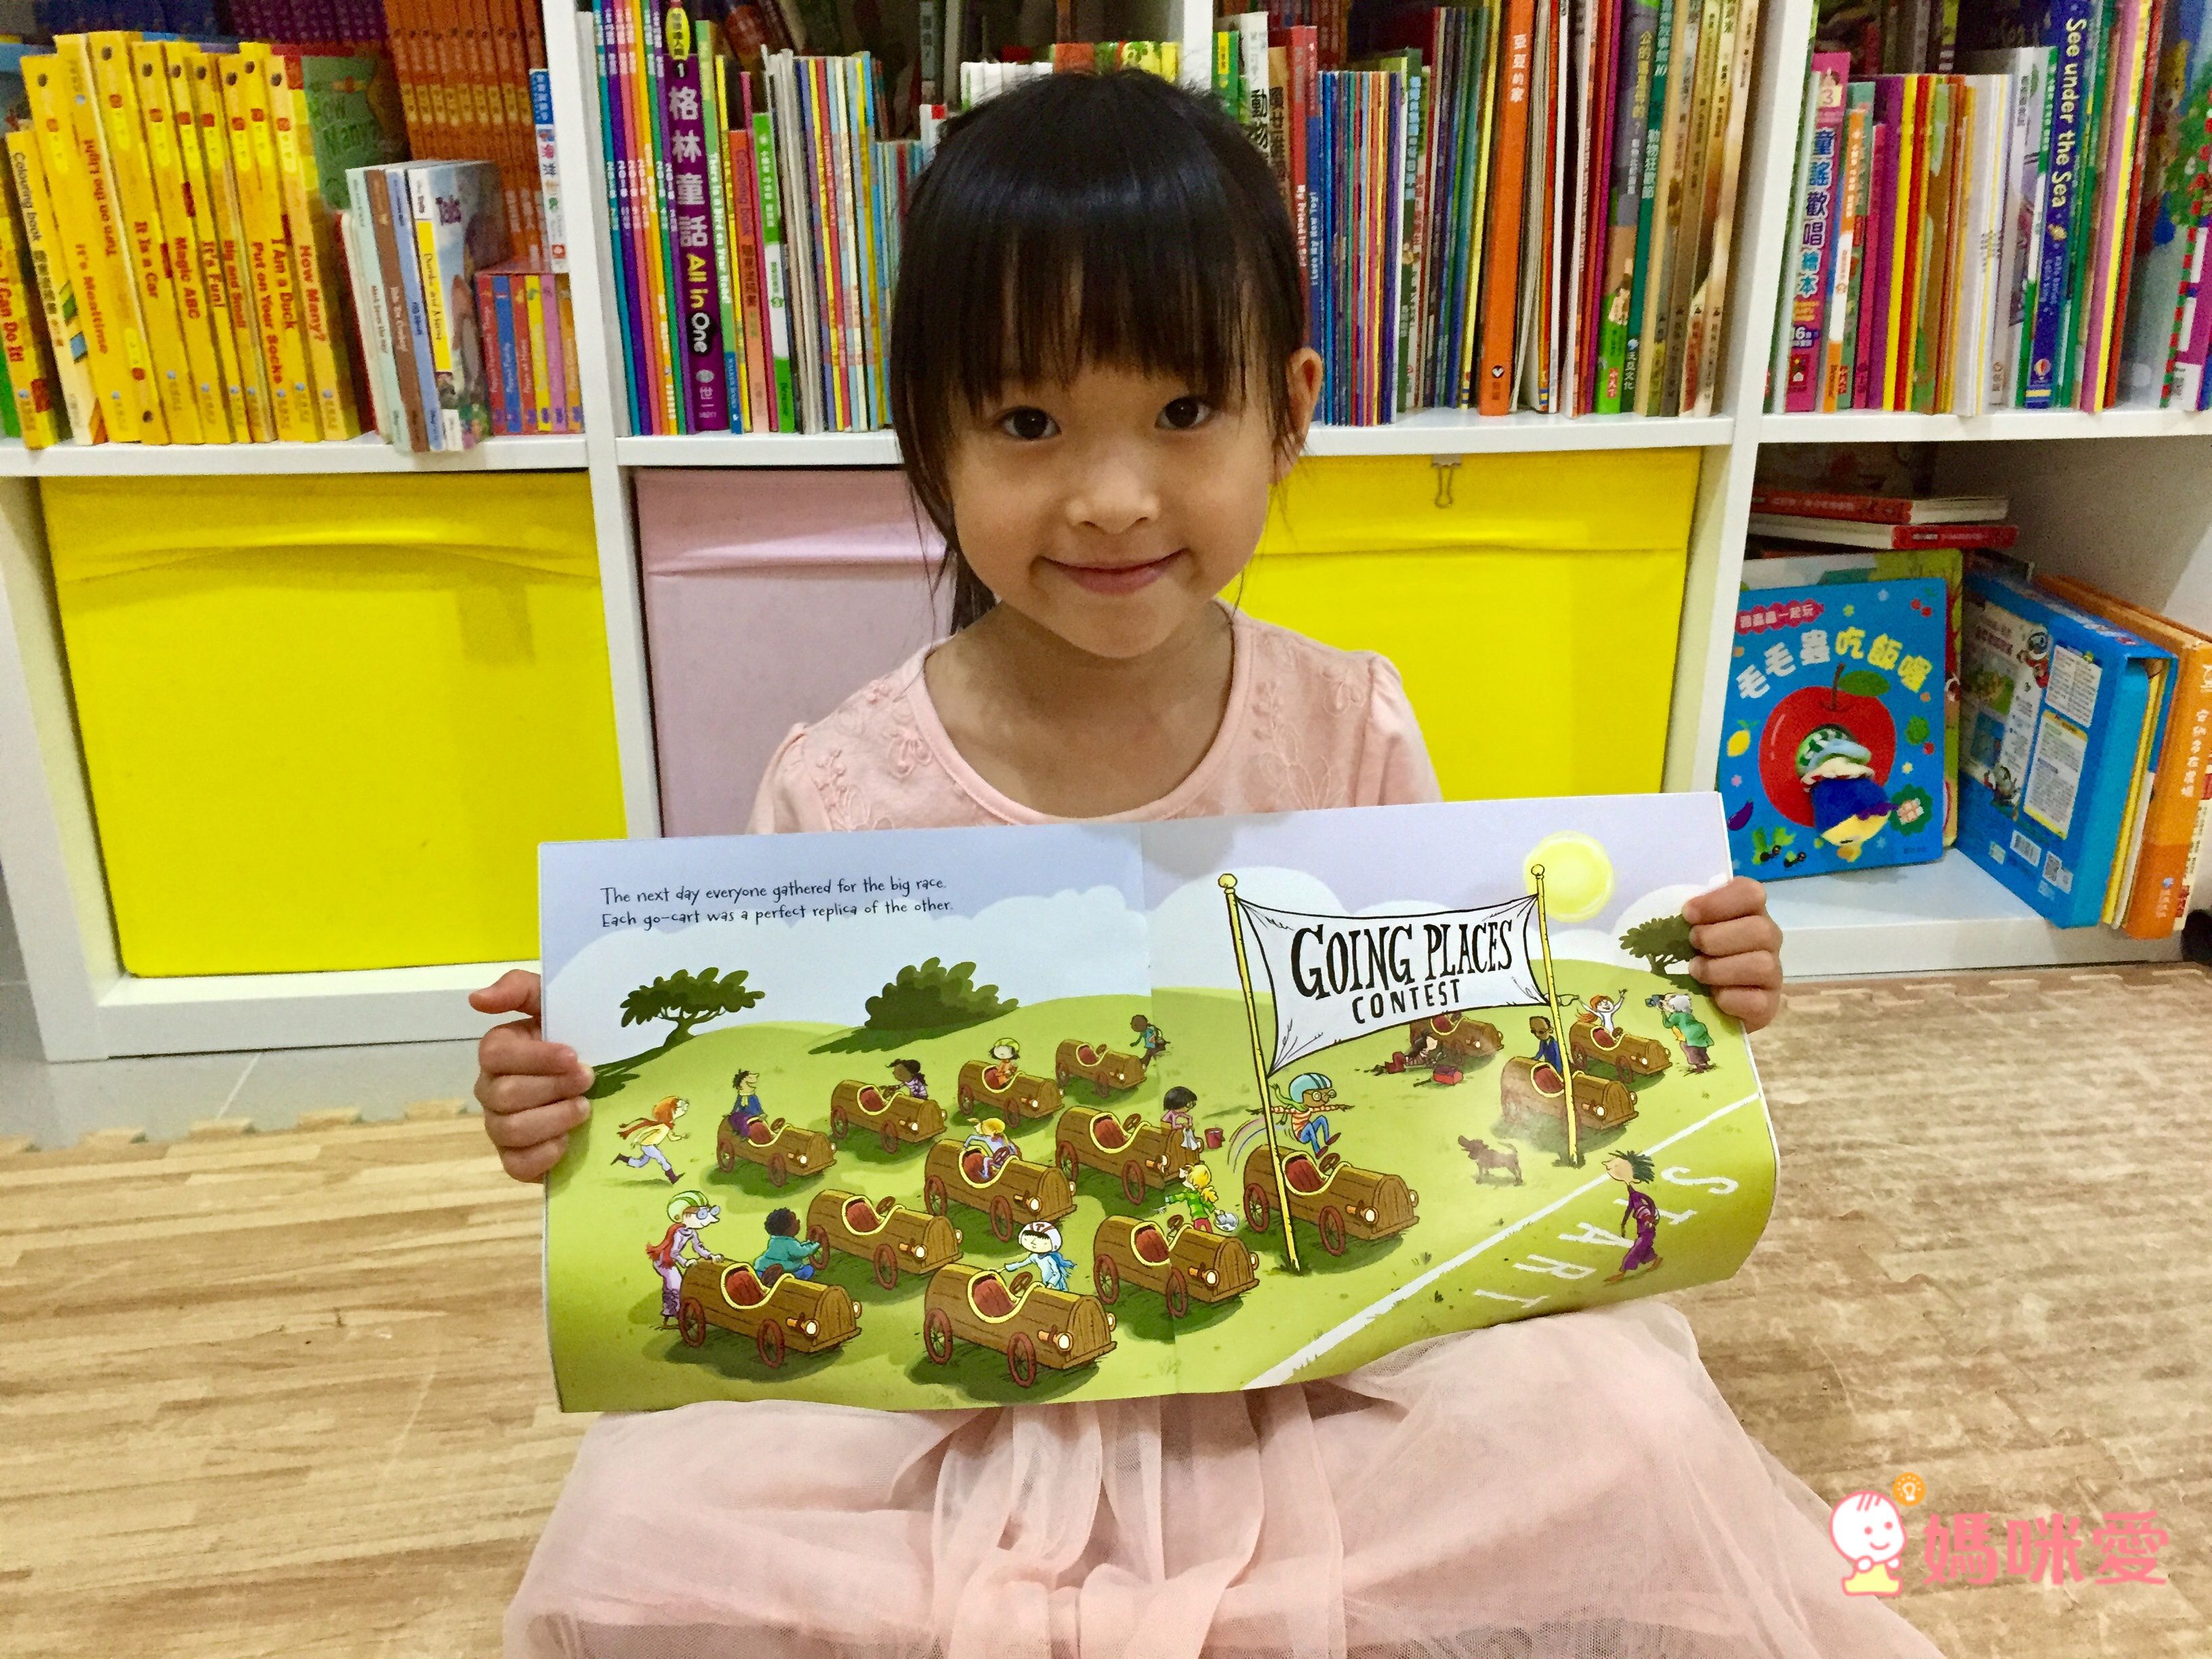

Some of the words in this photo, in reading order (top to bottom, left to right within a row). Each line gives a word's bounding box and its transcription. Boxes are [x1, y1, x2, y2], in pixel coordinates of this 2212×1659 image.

[2066, 18, 2087, 57] See
[2060, 62, 2081, 125] under
[84, 138, 100, 176] Light
[668, 86, 709, 247] 格林童話
[2055, 129, 2076, 167] the
[13, 151, 33, 209] Colouring
[24, 211, 43, 242] book
[94, 180, 107, 201] the
[2051, 171, 2072, 209] Sea
[98, 205, 110, 224] on
[741, 207, 754, 236] book
[102, 227, 117, 258] Turn
[250, 241, 266, 268] Put
[272, 248, 288, 274] Am
[174, 237, 192, 283] Magic
[183, 287, 201, 321] ABC
[228, 265, 240, 289] and
[255, 272, 269, 293] on
[299, 245, 314, 283] How
[686, 253, 708, 283] All
[144, 272, 159, 299] Car
[690, 289, 708, 309] In
[83, 276, 109, 354] Mealtime
[231, 291, 247, 329] Small
[260, 294, 274, 329] Your
[279, 291, 298, 330] Duck
[304, 288, 327, 342] Many?
[3, 321, 19, 342] Do
[691, 312, 710, 353] One
[265, 334, 284, 384] Socks
[600, 886, 630, 905] The
[637, 888, 670, 903] next
[676, 885, 699, 905] day
[705, 886, 767, 904] everyone
[773, 879, 831, 903] gathered
[837, 877, 857, 893] for
[863, 876, 885, 892] the
[890, 876, 910, 897] big
[916, 878, 946, 890] race.
[602, 911, 637, 928] Each
[644, 910, 699, 930] go-cart
[708, 911, 734, 922] was
[741, 910, 749, 921] a
[755, 905, 805, 924] perfect
[813, 902, 857, 922] replica
[864, 899, 878, 914] of
[885, 898, 907, 914] the
[914, 899, 953, 912] other.
[1290, 924, 1413, 1001] GOING
[1423, 918, 1513, 981] PLACES
[1351, 979, 1461, 1025] CONTEST
